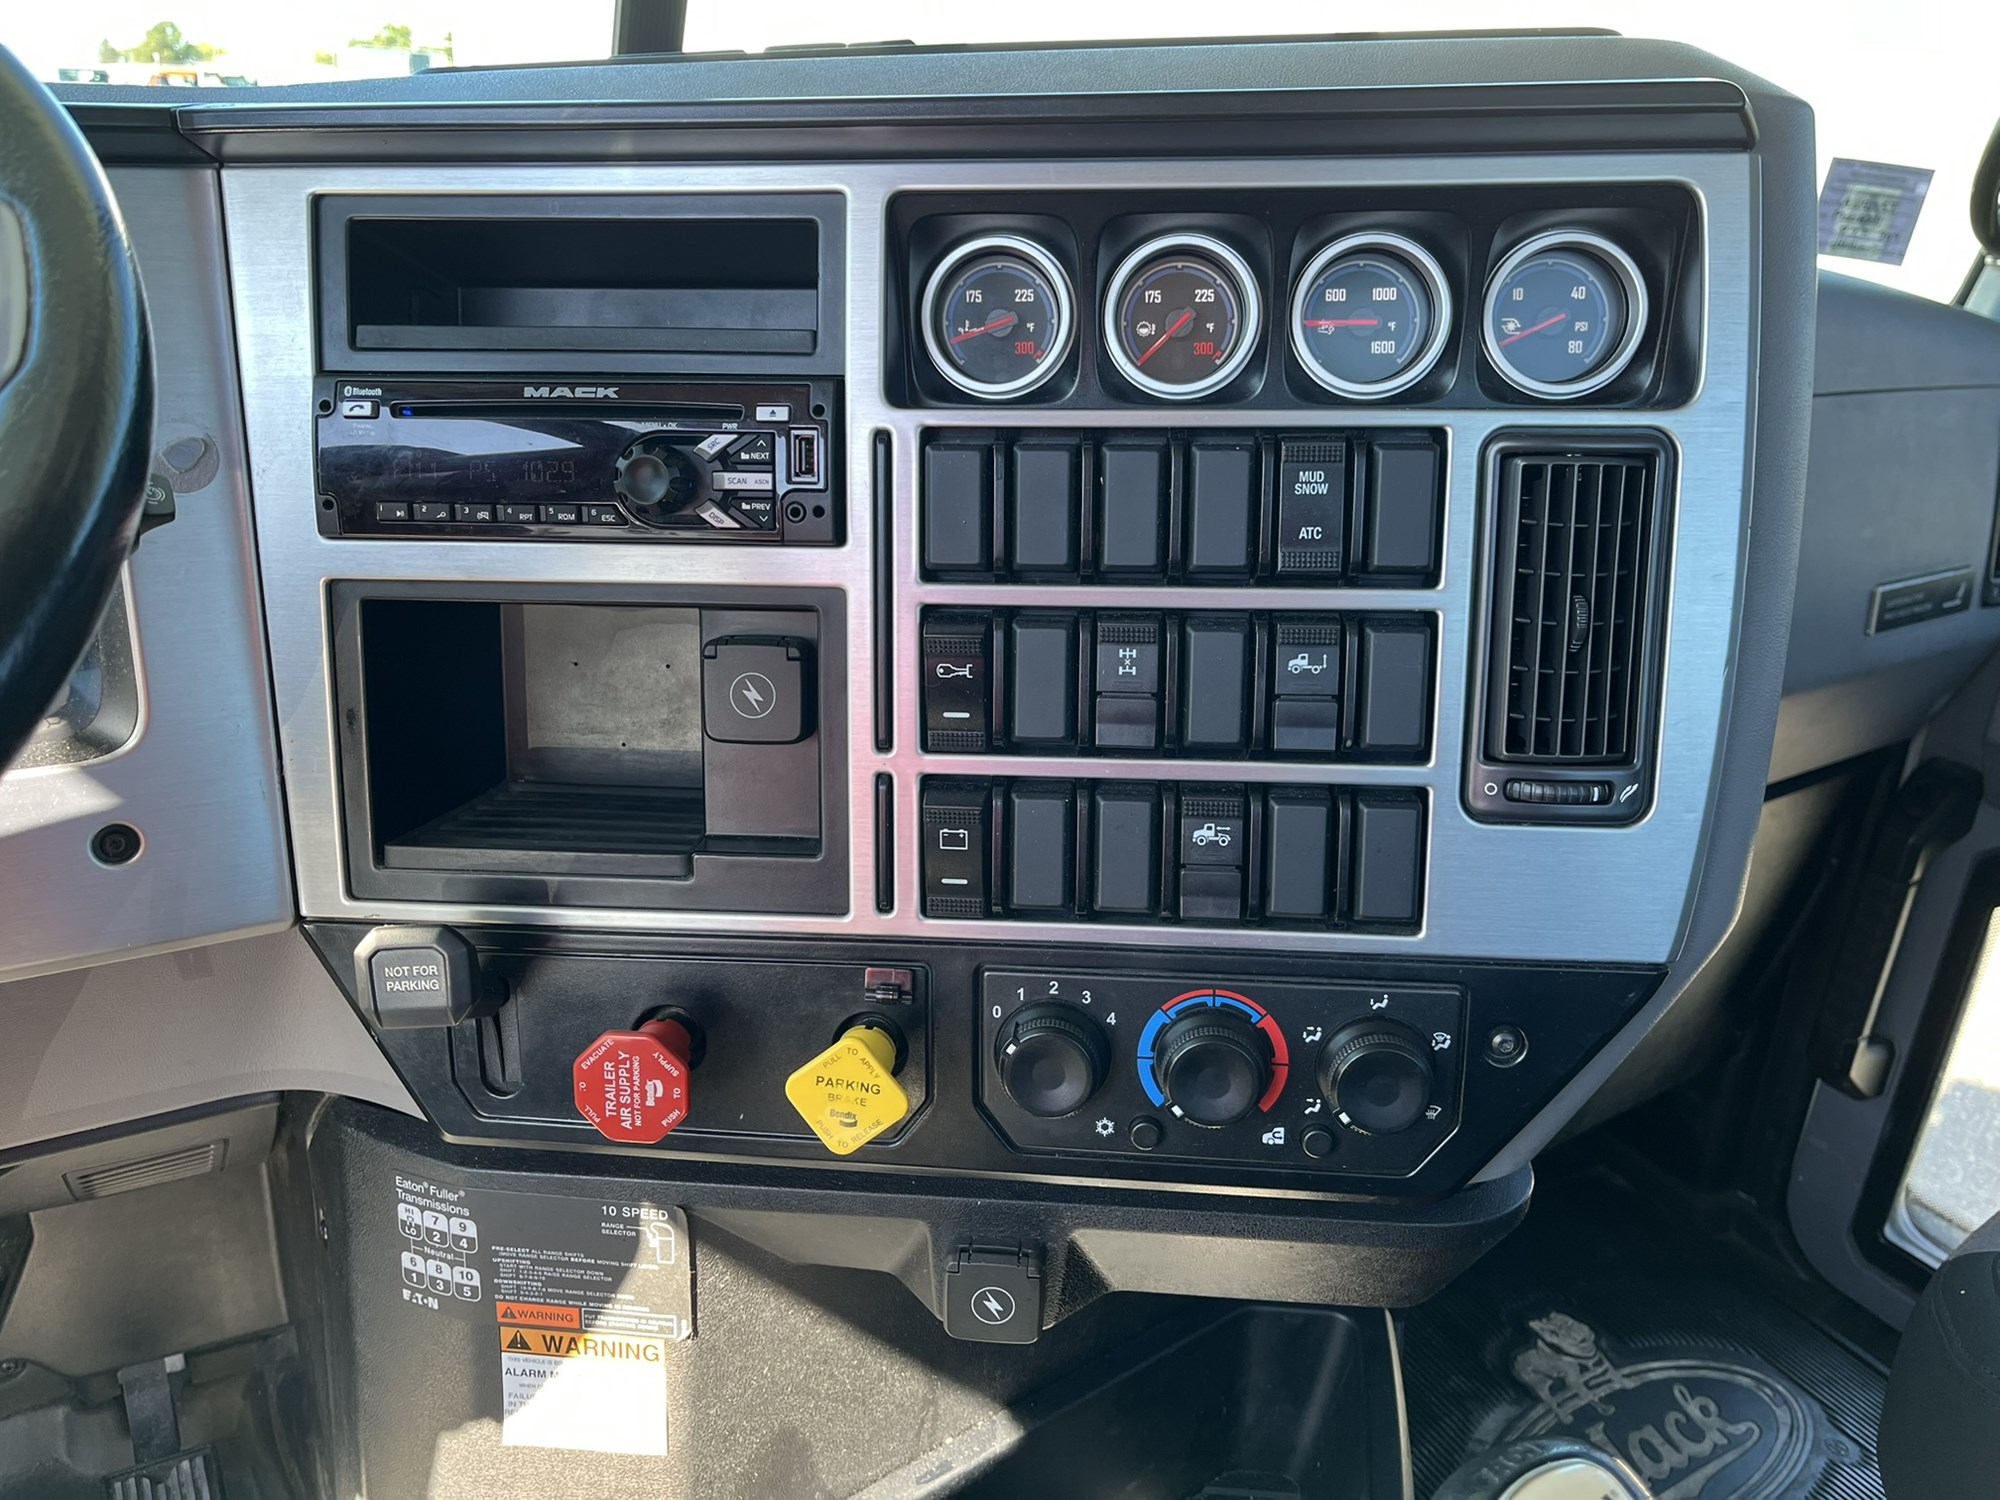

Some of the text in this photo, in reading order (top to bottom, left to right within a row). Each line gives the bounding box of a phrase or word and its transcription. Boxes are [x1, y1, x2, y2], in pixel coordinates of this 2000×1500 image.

[965, 290, 982, 303] 175
[1014, 289, 1034, 302] 225
[1145, 290, 1161, 303] 175
[1194, 289, 1214, 302] 225
[1325, 288, 1346, 302] 600
[1372, 287, 1397, 301] 1000
[1512, 287, 1523, 301] 10
[1571, 286, 1586, 299] 40
[1575, 321, 1588, 332] PSI
[1014, 341, 1034, 355] 300
[1193, 341, 1213, 355] 300
[1371, 341, 1395, 354] 1600
[1568, 340, 1583, 354] 80
[352, 387, 382, 396] Bluetooth
[523, 386, 619, 399] MACK
[707, 438, 721, 450] SRC
[750, 452, 769, 460] NEXT
[727, 477, 747, 485] SCAN
[1299, 471, 1325, 483] MUD
[1294, 483, 1328, 495] SNOW
[751, 503, 771, 511] PREV
[519, 513, 533, 521] RPT
[602, 514, 616, 522] ESC
[708, 511, 725, 525] DISP
[1298, 526, 1322, 540] ATC
[384, 965, 438, 977] NOT FOR
[386, 979, 440, 992] PARKING
[1048, 981, 1059, 995] 2
[1016, 987, 1024, 1001] 1
[1081, 990, 1091, 1004] 3
[992, 1005, 1002, 1018] 0
[1106, 1012, 1117, 1025] 4
[580, 1038, 615, 1070] EVACUATE
[822, 1047, 881, 1079] PULL TO APPLY
[604, 1061, 617, 1117] TRAILER
[618, 1050, 633, 1130] AIR SUPPLY
[632, 1056, 642, 1127] NOT FOR PARKING
[652, 1051, 681, 1127] PUSH TO SUPPLY
[815, 1075, 881, 1095] PARKING
[584, 1105, 601, 1123] PULL
[830, 1108, 857, 1120] Bendix
[816, 1118, 883, 1148] PUSH TO RELEASE
[395, 1188, 470, 1217] Transmissions
[405, 1206, 414, 1215] HI
[601, 1205, 669, 1221] 10 SPEED
[431, 1216, 439, 1226] 7
[459, 1222, 467, 1233] 9
[405, 1226, 417, 1236] LO
[433, 1231, 441, 1242] 2
[601, 1229, 636, 1237] SELECTOR
[460, 1238, 468, 1249] 4
[491, 1245, 530, 1253] PRE-SELECT
[424, 1246, 454, 1260] Neutral
[410, 1257, 417, 1267] 6
[492, 1257, 531, 1265] UPSHIFTING
[435, 1264, 443, 1275] 8
[460, 1270, 474, 1281] 10
[411, 1273, 417, 1283] 1
[493, 1278, 542, 1287] DOWNSHIFTING
[436, 1280, 444, 1291] 3
[463, 1287, 472, 1297] 5
[518, 1309, 574, 1323] WARNING
[541, 1334, 659, 1362] WARNING
[521, 1357, 545, 1365] VEHICLE
[504, 1367, 547, 1378] ALARM
[508, 1392, 535, 1400] FAILU
